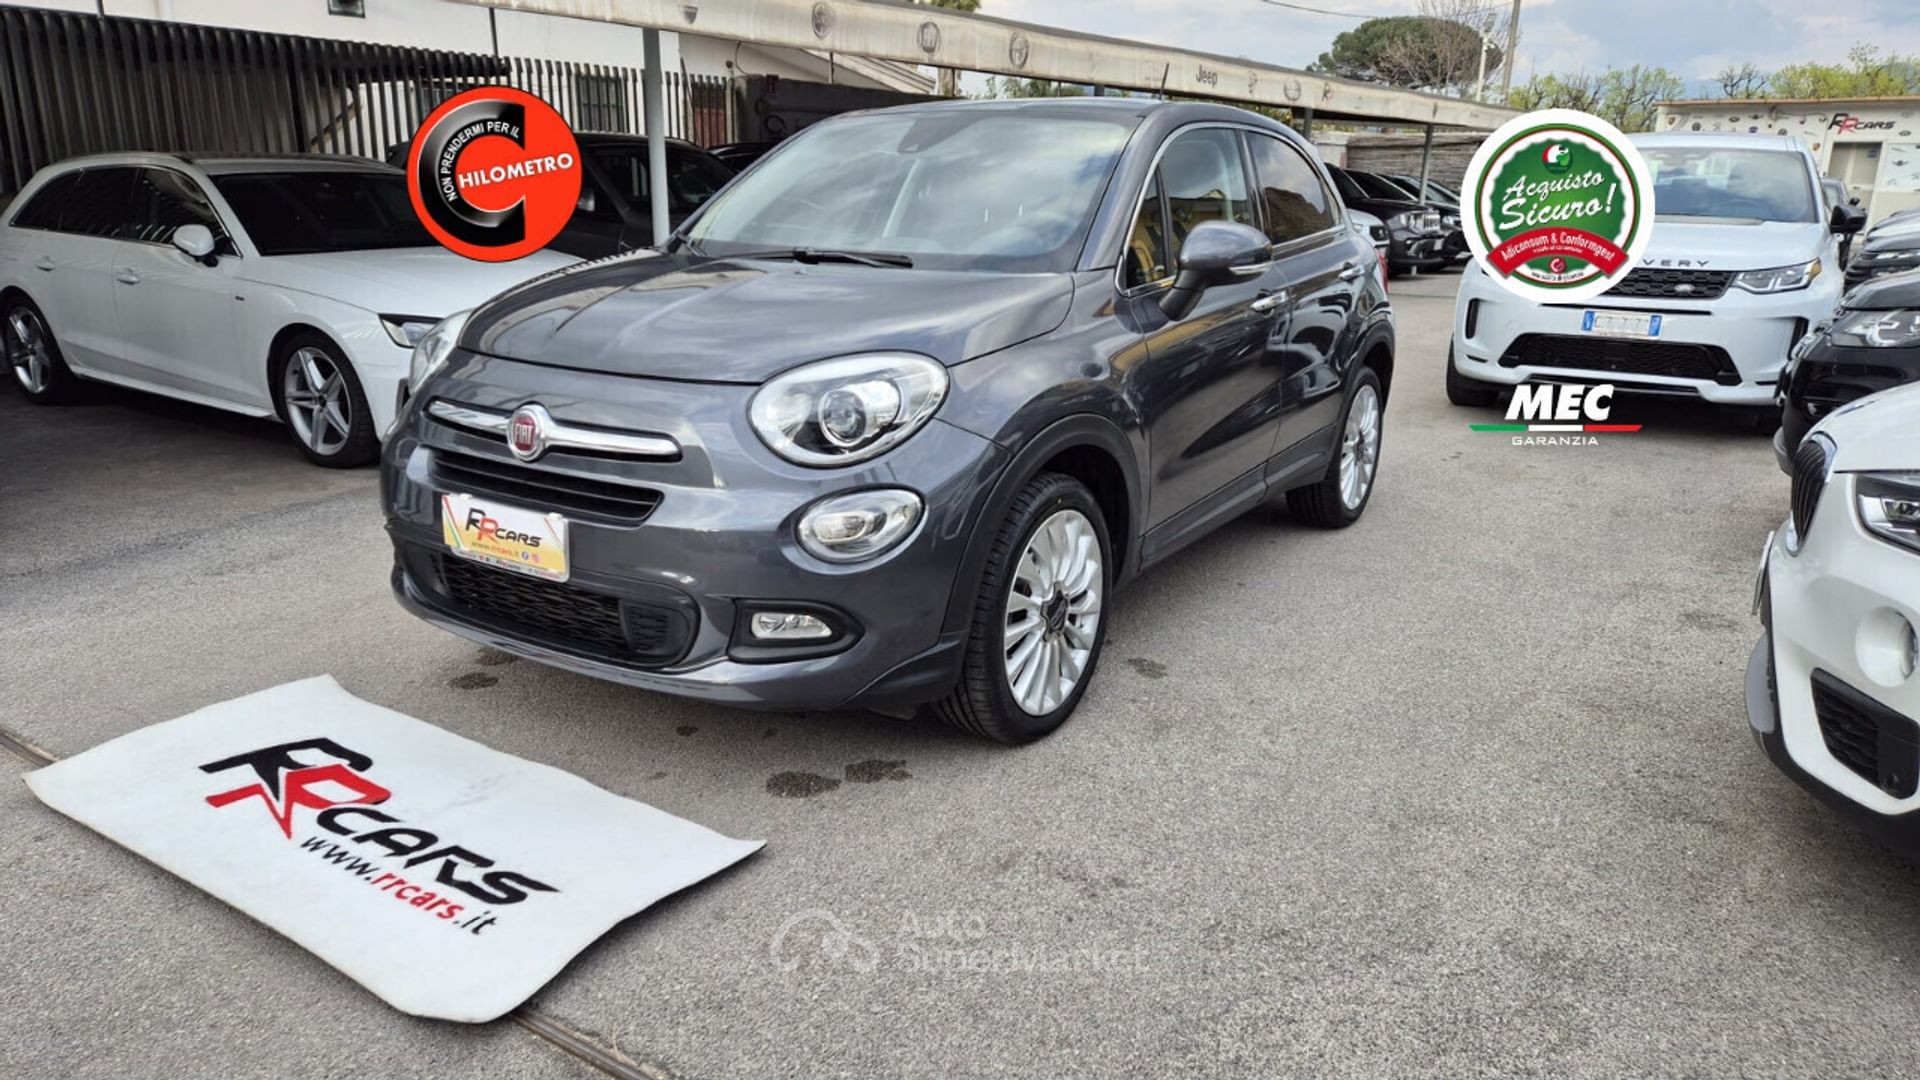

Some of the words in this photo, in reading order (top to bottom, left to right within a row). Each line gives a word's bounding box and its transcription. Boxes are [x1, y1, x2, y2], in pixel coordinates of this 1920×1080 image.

[1196, 64, 1218, 88] Jeep
[513, 423, 535, 445] FIAT
[300, 836, 499, 936] www.rrcars.it
